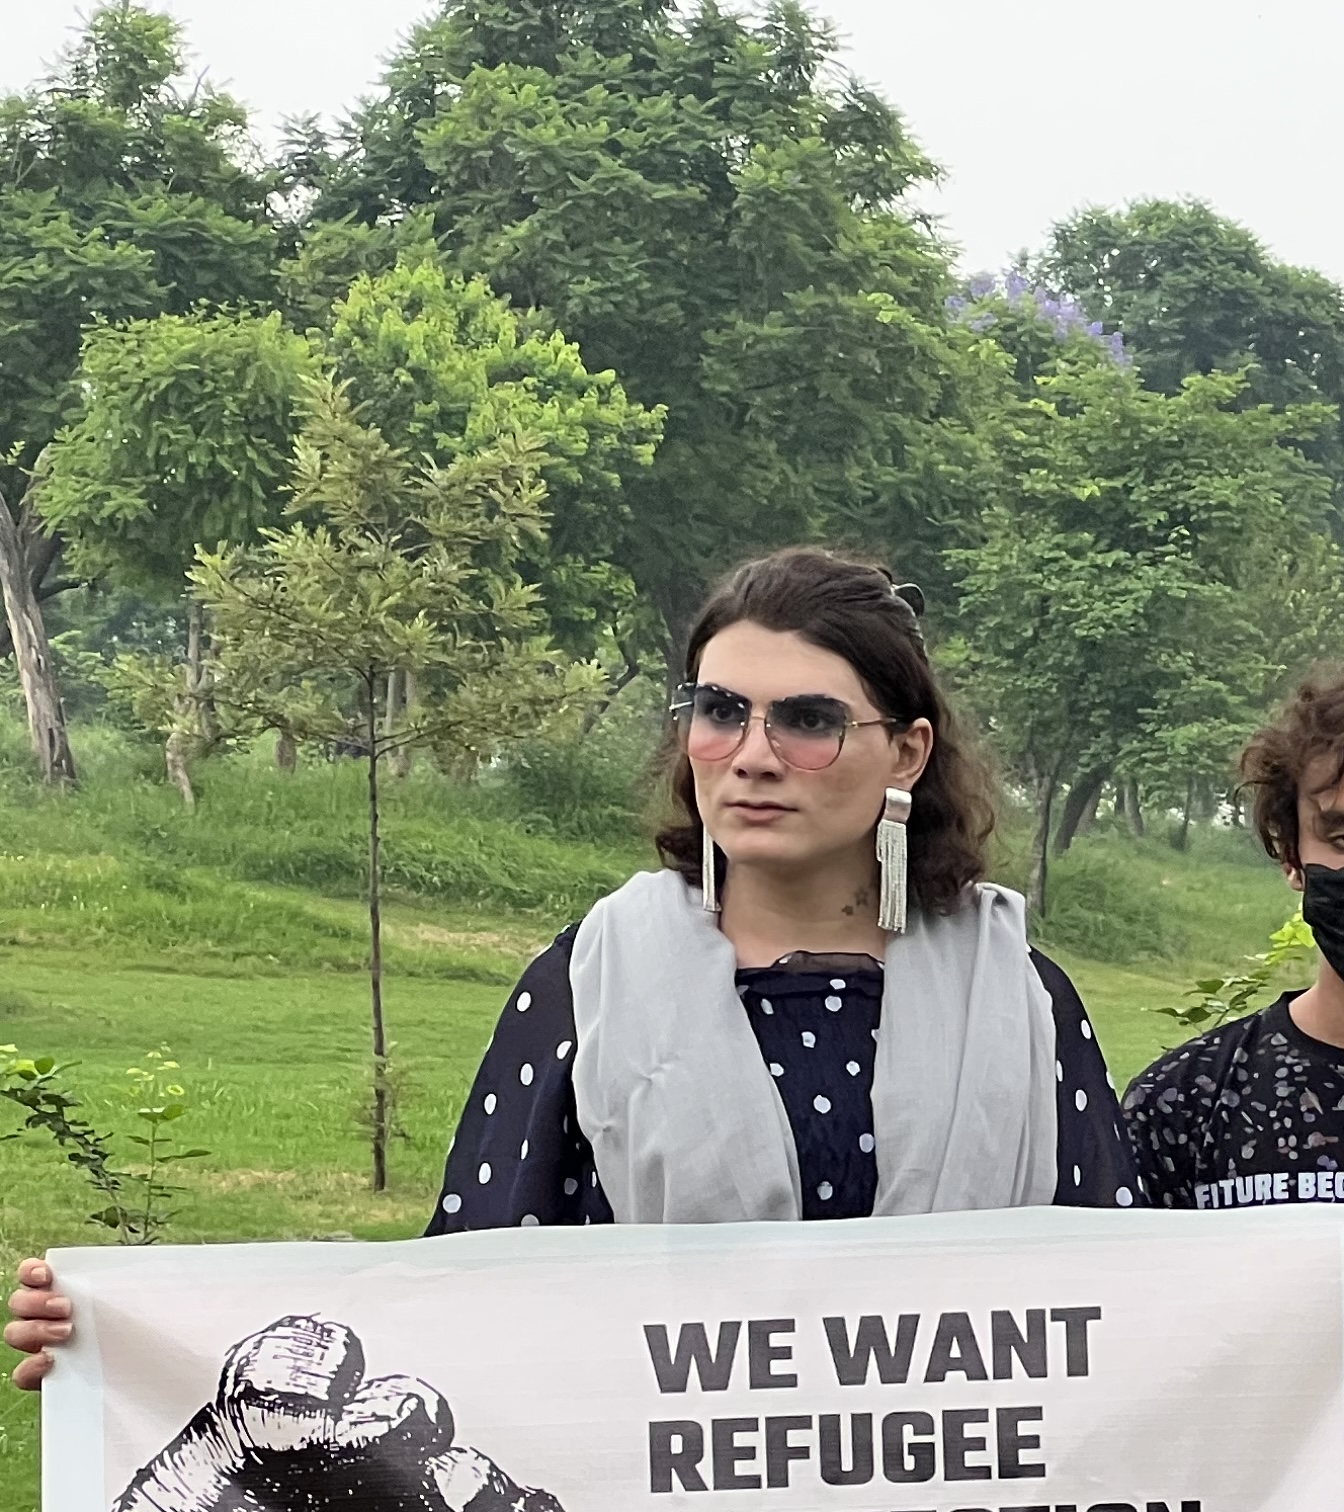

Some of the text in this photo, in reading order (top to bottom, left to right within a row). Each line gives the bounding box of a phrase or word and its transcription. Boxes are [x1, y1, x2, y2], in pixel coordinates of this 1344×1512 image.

[642, 1305, 1102, 1394] WE WANT
[648, 1405, 1047, 1494] REFUGEE
